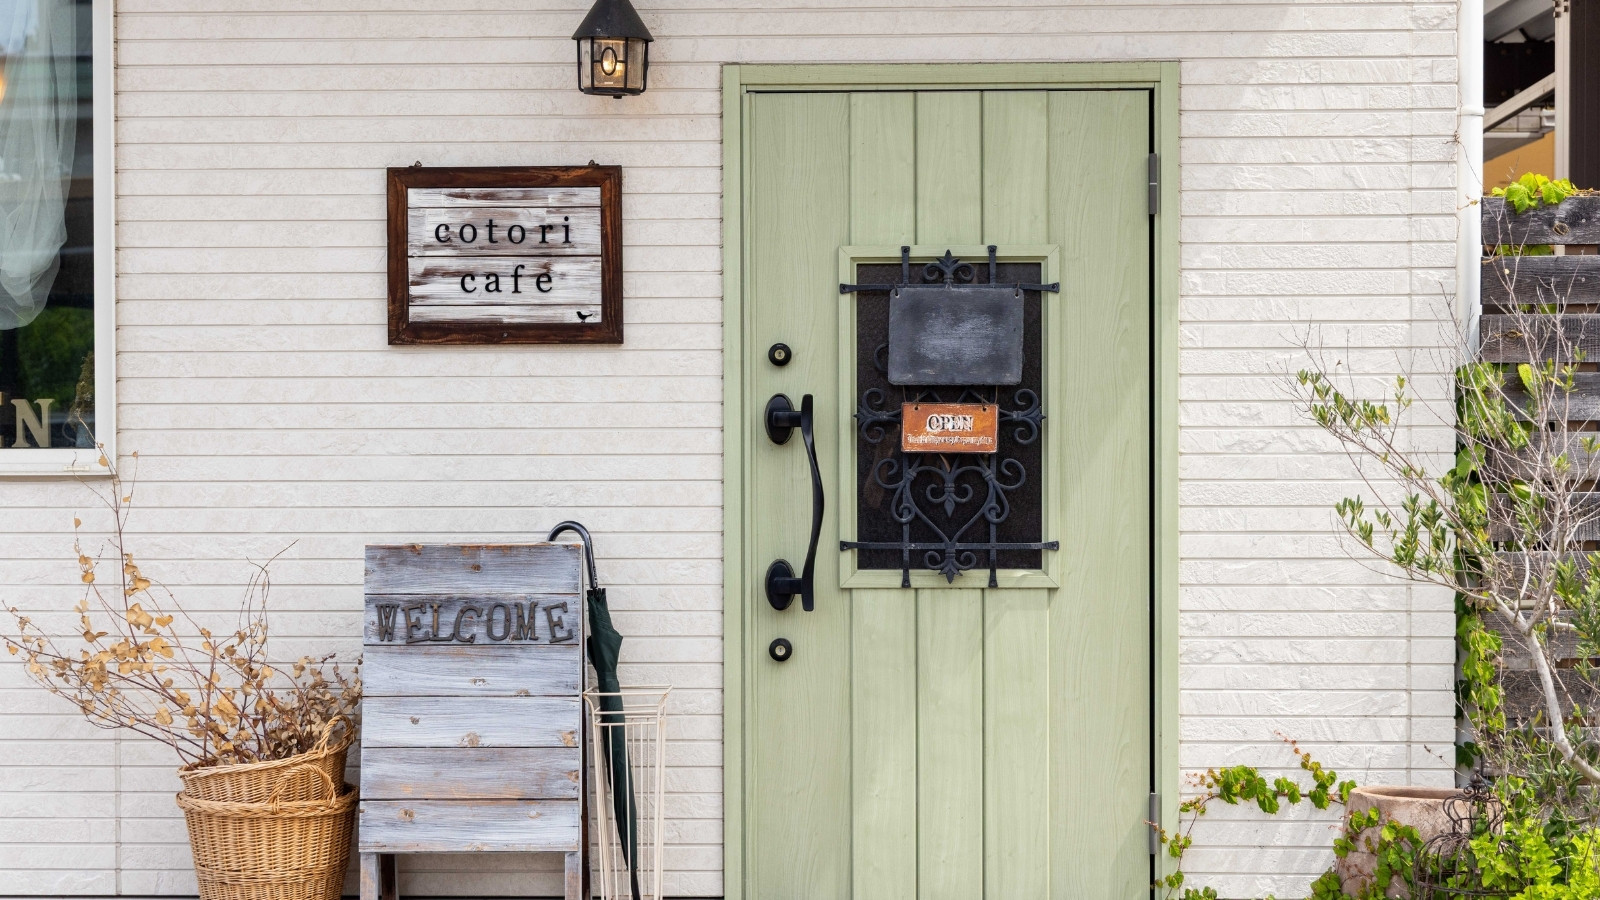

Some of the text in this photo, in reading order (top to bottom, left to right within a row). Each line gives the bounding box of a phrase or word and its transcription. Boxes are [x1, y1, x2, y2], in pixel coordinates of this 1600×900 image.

[435, 216, 572, 244] cotori
[460, 265, 553, 294] cafe
[0, 391, 55, 448] N
[927, 415, 974, 431] OPEN
[376, 602, 574, 643] WELCOME
